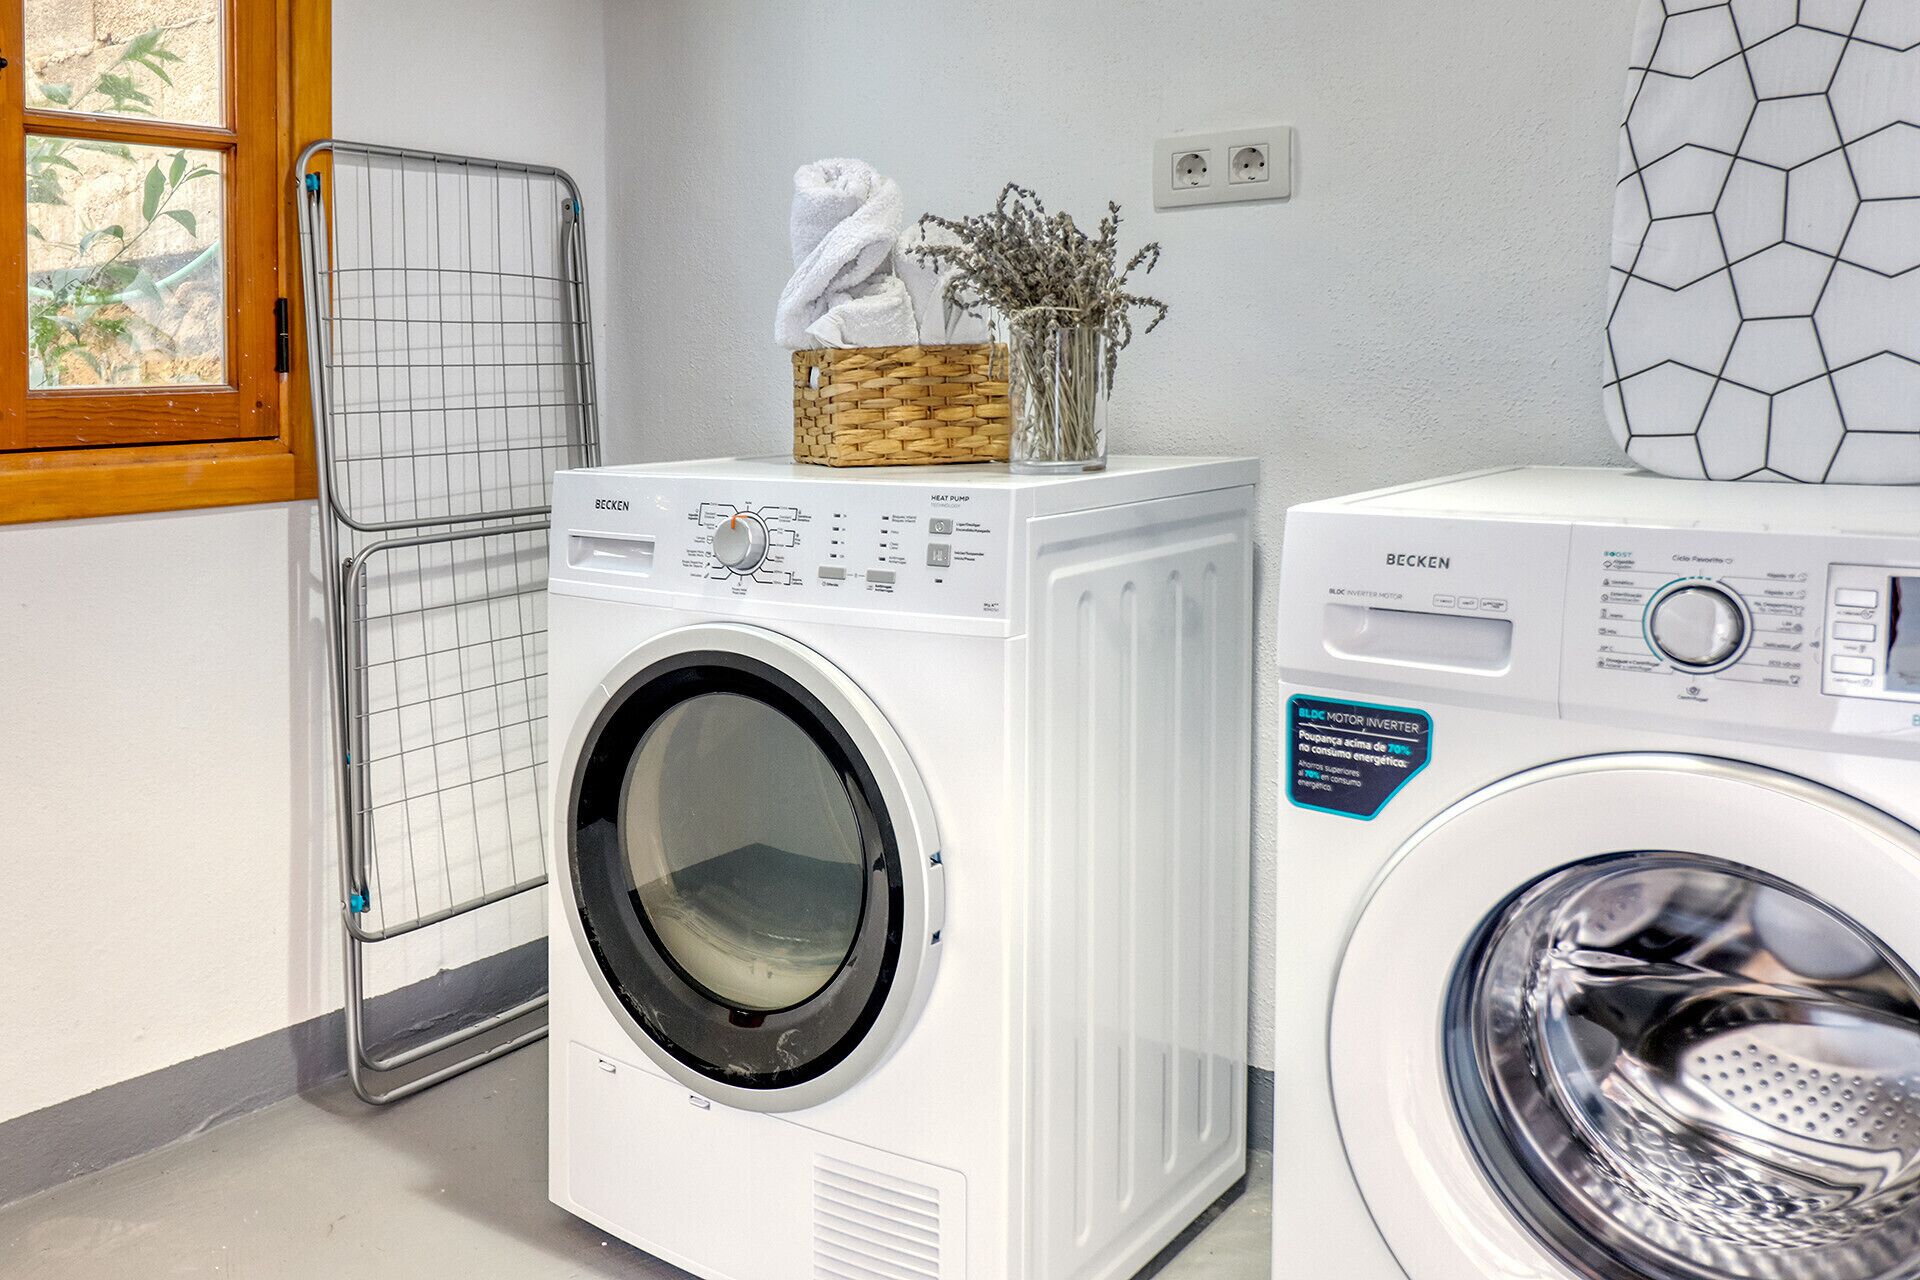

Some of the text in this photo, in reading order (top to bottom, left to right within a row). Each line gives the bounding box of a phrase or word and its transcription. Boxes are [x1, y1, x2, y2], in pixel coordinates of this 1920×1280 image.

[595, 499, 630, 511] BECKEN
[1386, 553, 1450, 570] BECKEN
[1692, 556, 1724, 564] Favorito
[1347, 590, 1378, 598] INVERTER
[1379, 592, 1403, 600] MOTOR
[1298, 707, 1419, 732] BLDC MOTOR INVERTER
[1299, 730, 1411, 755] Poupança acima de 70%
[1299, 743, 1310, 751] no
[1311, 746, 1352, 759] consumo
[1298, 760, 1360, 777] Ahorros superiores
[1304, 770, 1320, 778] 70%
[1331, 777, 1362, 787] consumo
